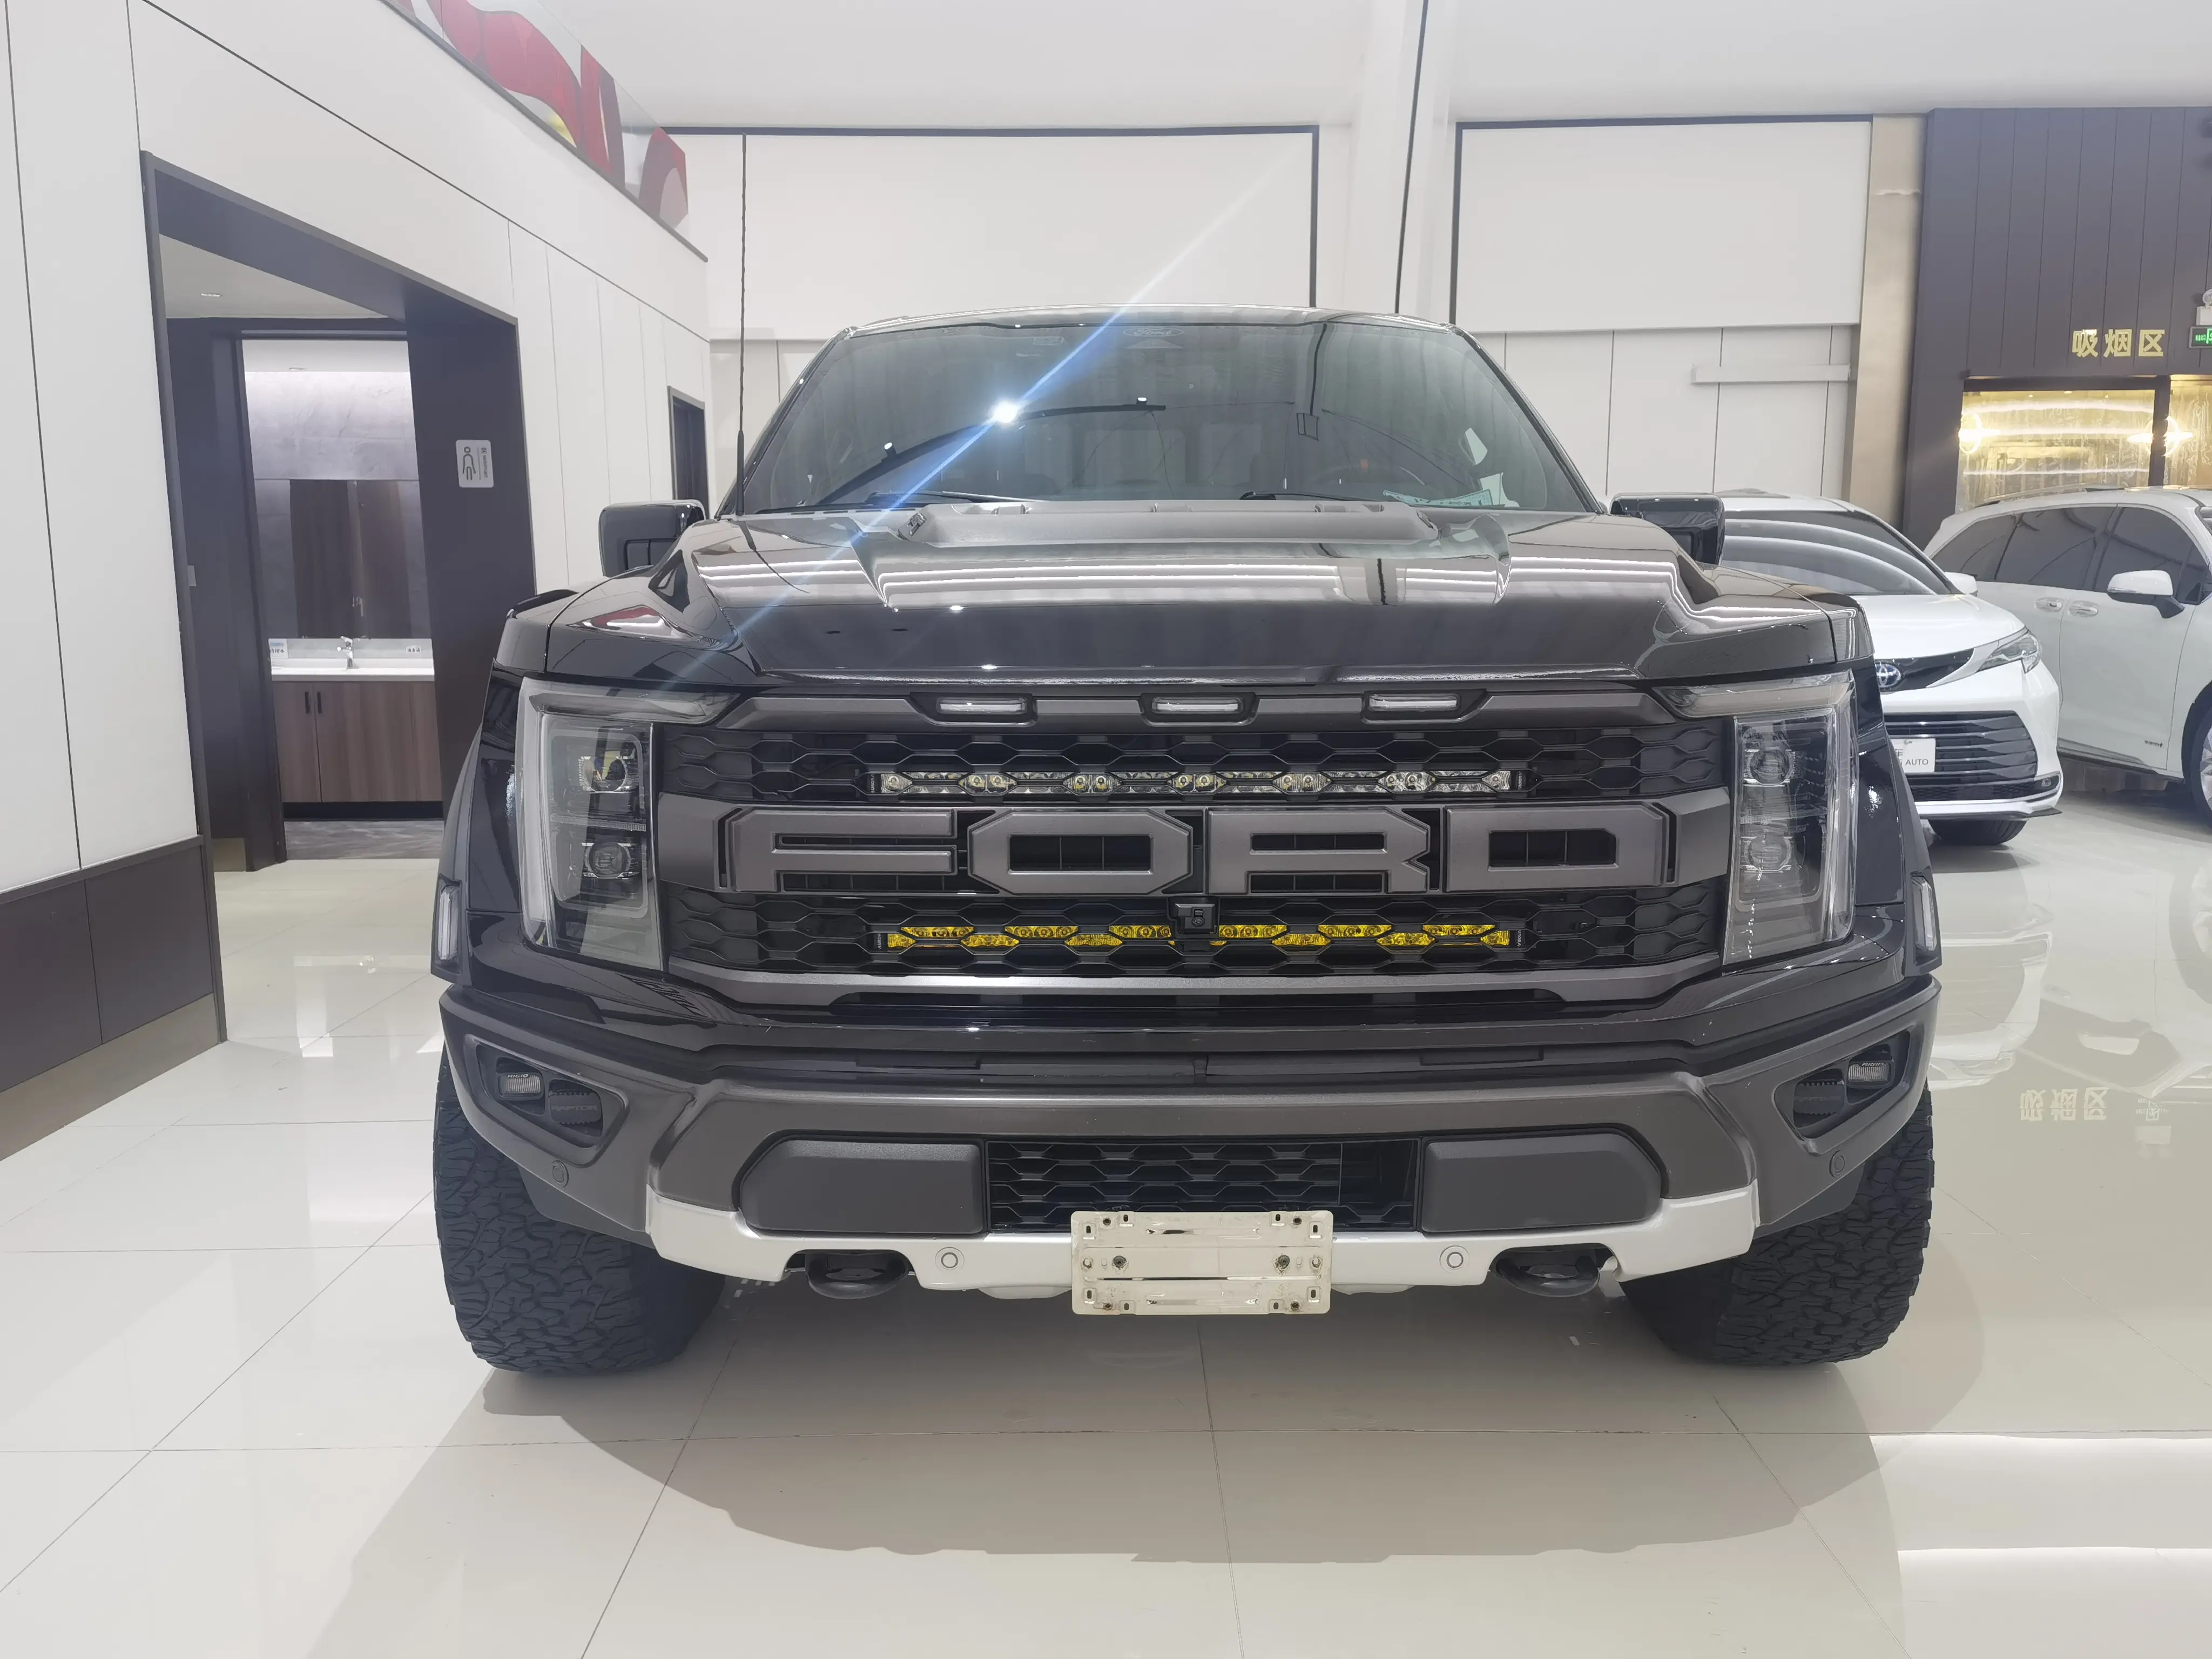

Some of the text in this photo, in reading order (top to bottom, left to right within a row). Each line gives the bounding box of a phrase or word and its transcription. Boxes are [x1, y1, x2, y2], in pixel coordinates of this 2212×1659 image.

[2072, 328, 2165, 358] 吸烟区
[729, 806, 1667, 894] FORD
